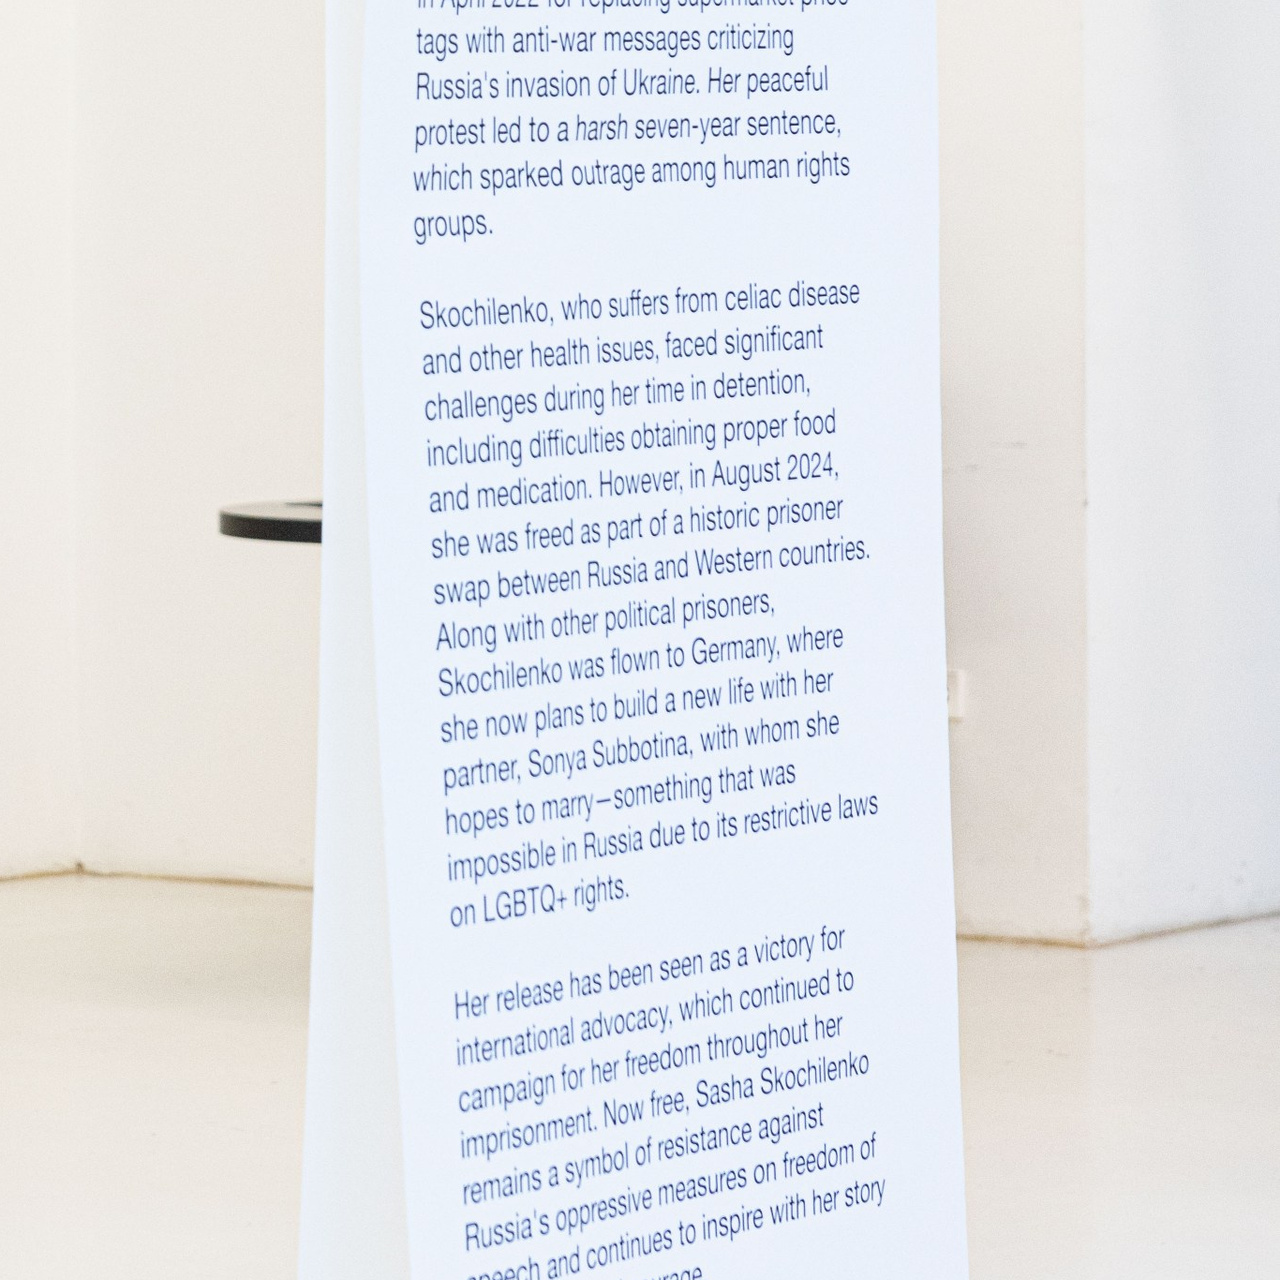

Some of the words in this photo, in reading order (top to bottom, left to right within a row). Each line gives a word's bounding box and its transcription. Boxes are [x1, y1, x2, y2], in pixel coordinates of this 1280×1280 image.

[416, 28, 458, 61] tags
[466, 26, 504, 53] with
[513, 25, 596, 53] anti-war
[604, 30, 701, 58] messages
[708, 23, 793, 56] criticizing
[417, 72, 499, 100] Russia's
[507, 70, 590, 97] invasion
[598, 69, 617, 96] of
[624, 68, 699, 96] Ukraine.
[708, 67, 741, 93] Her
[747, 65, 828, 99] peaceful
[413, 163, 472, 191] which
[480, 159, 563, 196] sparked
[572, 160, 645, 191] outrage
[652, 161, 716, 188] among
[724, 154, 789, 180] human
[797, 151, 850, 184] rights
[414, 214, 492, 245] groups.
[420, 296, 553, 329] Skochilenko,
[561, 293, 602, 320] who
[609, 289, 669, 318] suffers
[675, 287, 717, 313] from
[725, 283, 781, 311] celiac
[789, 281, 860, 307] disease
[425, 390, 537, 423] challenges
[545, 383, 604, 415] during
[612, 380, 639, 406] her
[645, 377, 684, 404] time
[691, 374, 706, 400] in
[714, 369, 810, 399] detention,
[427, 435, 522, 467] including
[530, 426, 625, 458] difficulties
[631, 418, 715, 450] obtaining
[724, 418, 787, 449] proper
[794, 407, 835, 436] food
[430, 482, 469, 513] and
[478, 474, 592, 508] medication.
[600, 470, 683, 497] However,
[690, 462, 705, 488] in
[712, 457, 780, 491] August
[788, 451, 838, 480] 2024,
[434, 579, 490, 607] swap
[498, 570, 580, 598] between
[588, 557, 648, 588] Russia
[655, 551, 688, 581] and
[695, 547, 772, 576] Western
[779, 536, 869, 567] countries.
[436, 622, 496, 653] Along
[504, 613, 544, 642] with
[551, 609, 598, 637] other
[605, 597, 675, 638] political
[683, 593, 774, 629] prisoners,
[439, 658, 562, 697] Skochilenko
[569, 657, 604, 680] was
[611, 648, 659, 674] flown
[666, 643, 684, 667] to
[692, 636, 779, 665] Germany,
[787, 626, 843, 653] where
[444, 759, 520, 796] partner,
[529, 749, 587, 779] Sonya
[593, 732, 693, 768] Subbotina,
[700, 722, 738, 752] with
[745, 718, 799, 745] whom
[807, 710, 839, 737] she
[446, 807, 509, 838] hopes
[515, 800, 535, 824] to
[718, 765, 754, 793] that
[760, 764, 796, 787] was
[451, 904, 475, 927] on
[484, 884, 567, 922] LGBTQ+
[574, 875, 629, 912] rights.
[457, 1017, 574, 1065] international
[581, 1006, 672, 1041] advocacy,
[679, 988, 732, 1021] which
[740, 969, 830, 1010] continued
[836, 968, 854, 992] to
[459, 1072, 555, 1112] campaign
[561, 1064, 585, 1091] for
[591, 1059, 619, 1084] her
[625, 1043, 700, 1077] freedom
[707, 1018, 808, 1060] throughout
[815, 1014, 843, 1040] her
[461, 1107, 597, 1160] imprisonment.
[604, 1099, 643, 1127] Now
[650, 1090, 689, 1117] free,
[697, 1074, 754, 1107] Sasha
[761, 1051, 869, 1095] Skochilenko
[464, 1168, 541, 1204] remains
[549, 1166, 559, 1187] a
[565, 1142, 628, 1188] symbol
[635, 1136, 651, 1166] of
[658, 1123, 752, 1160] resistance
[759, 1102, 823, 1144] against
[466, 1210, 549, 1251] Russia's
[556, 1187, 652, 1235] oppressive
[659, 1168, 747, 1205] measures
[754, 1162, 776, 1184] on
[783, 1144, 854, 1178] freedom
[860, 1131, 876, 1160] of
[548, 1245, 580, 1279] and
[587, 1229, 672, 1269] continues
[679, 1221, 696, 1246] to
[703, 1205, 763, 1241] inspire
[770, 1193, 806, 1224] with
[813, 1189, 839, 1215] her
[845, 1179, 885, 1207] story
